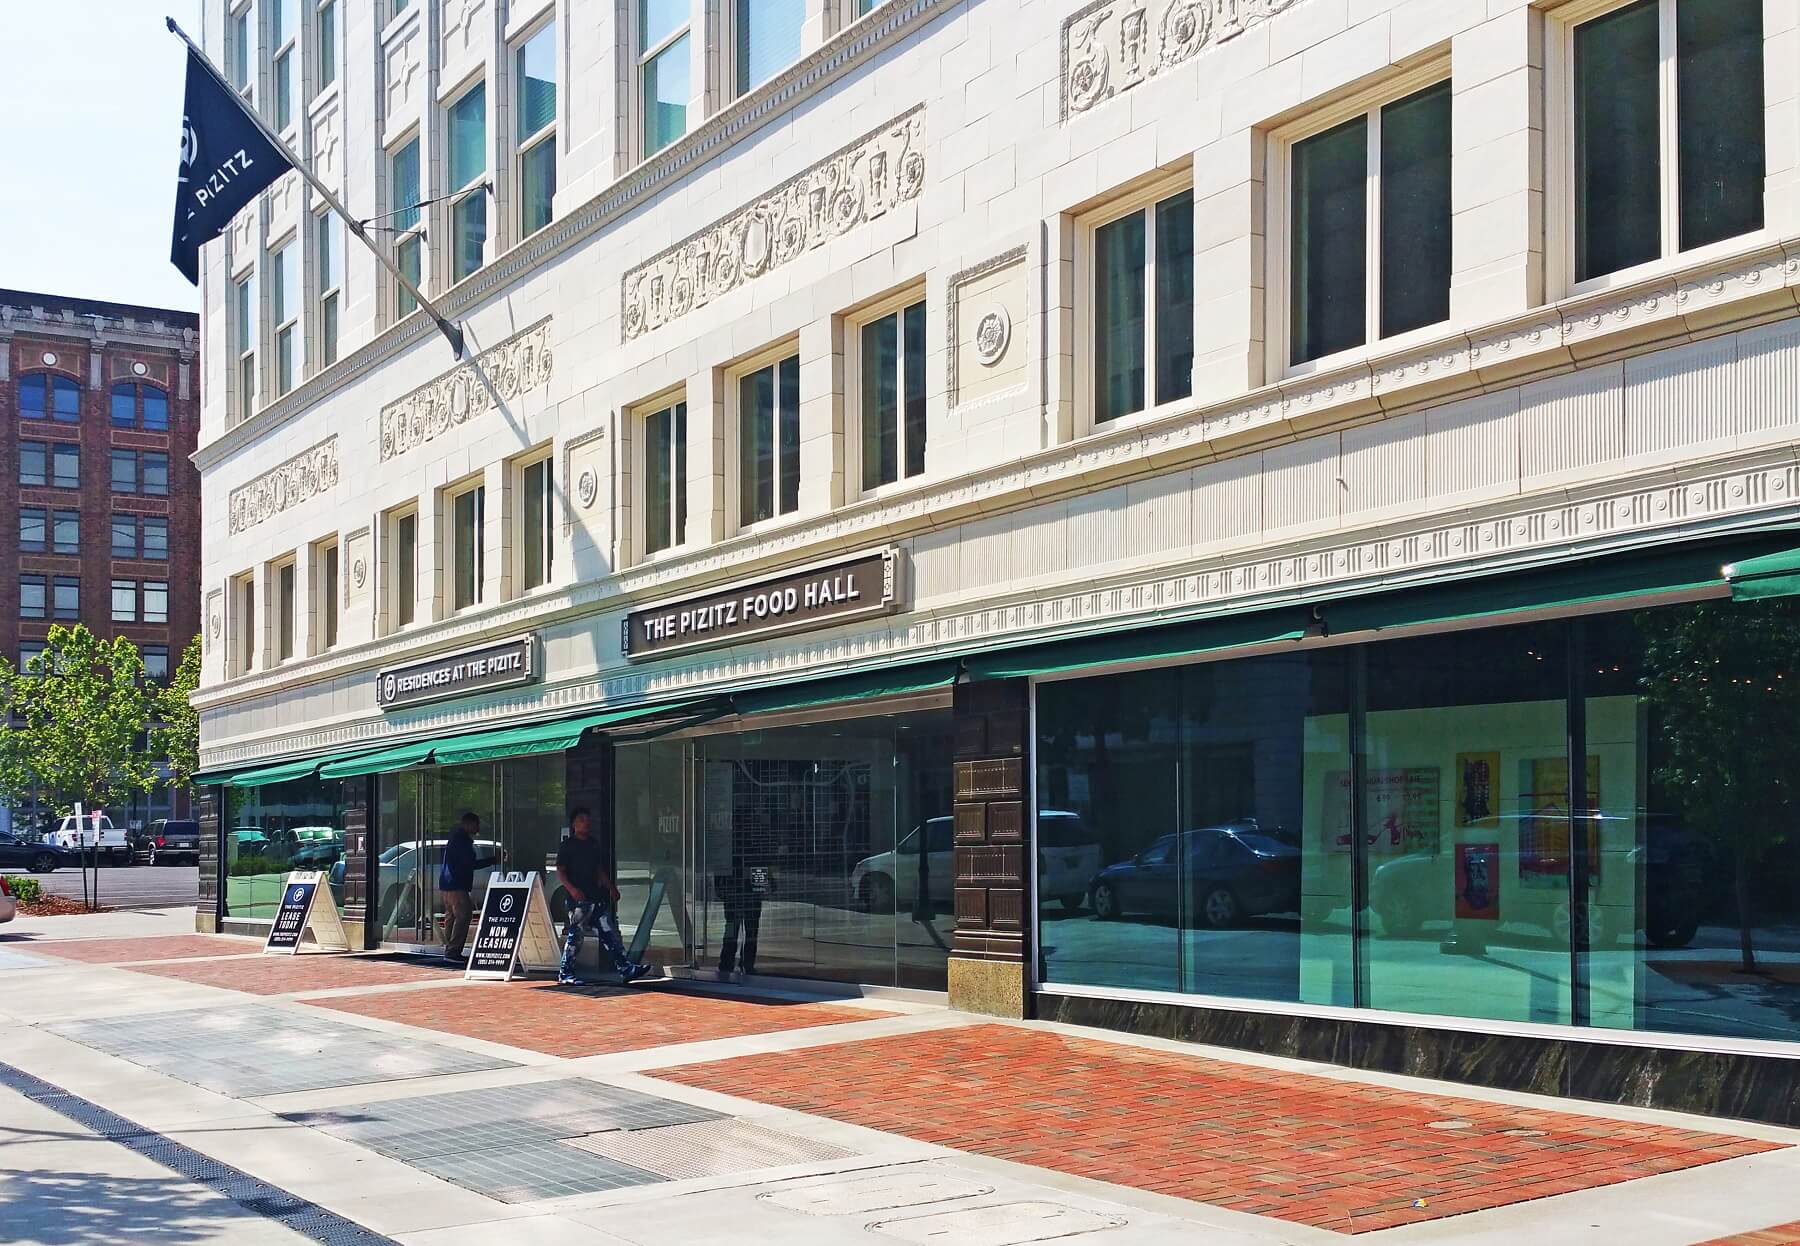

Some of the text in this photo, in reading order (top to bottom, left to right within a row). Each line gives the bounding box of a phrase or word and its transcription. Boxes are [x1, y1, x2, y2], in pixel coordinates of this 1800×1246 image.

[195, 149, 254, 207] PIZITZ
[644, 574, 860, 640] THE PIZITZ FOOD HALL
[397, 668, 450, 692] RESIDENCES
[452, 664, 465, 681] AT
[467, 659, 486, 678] THE
[487, 652, 521, 674] PIZITZ
[281, 912, 301, 920] LEASE
[279, 921, 298, 929] TODAY
[489, 926, 508, 937] NOW
[478, 938, 513, 948] LEASING
